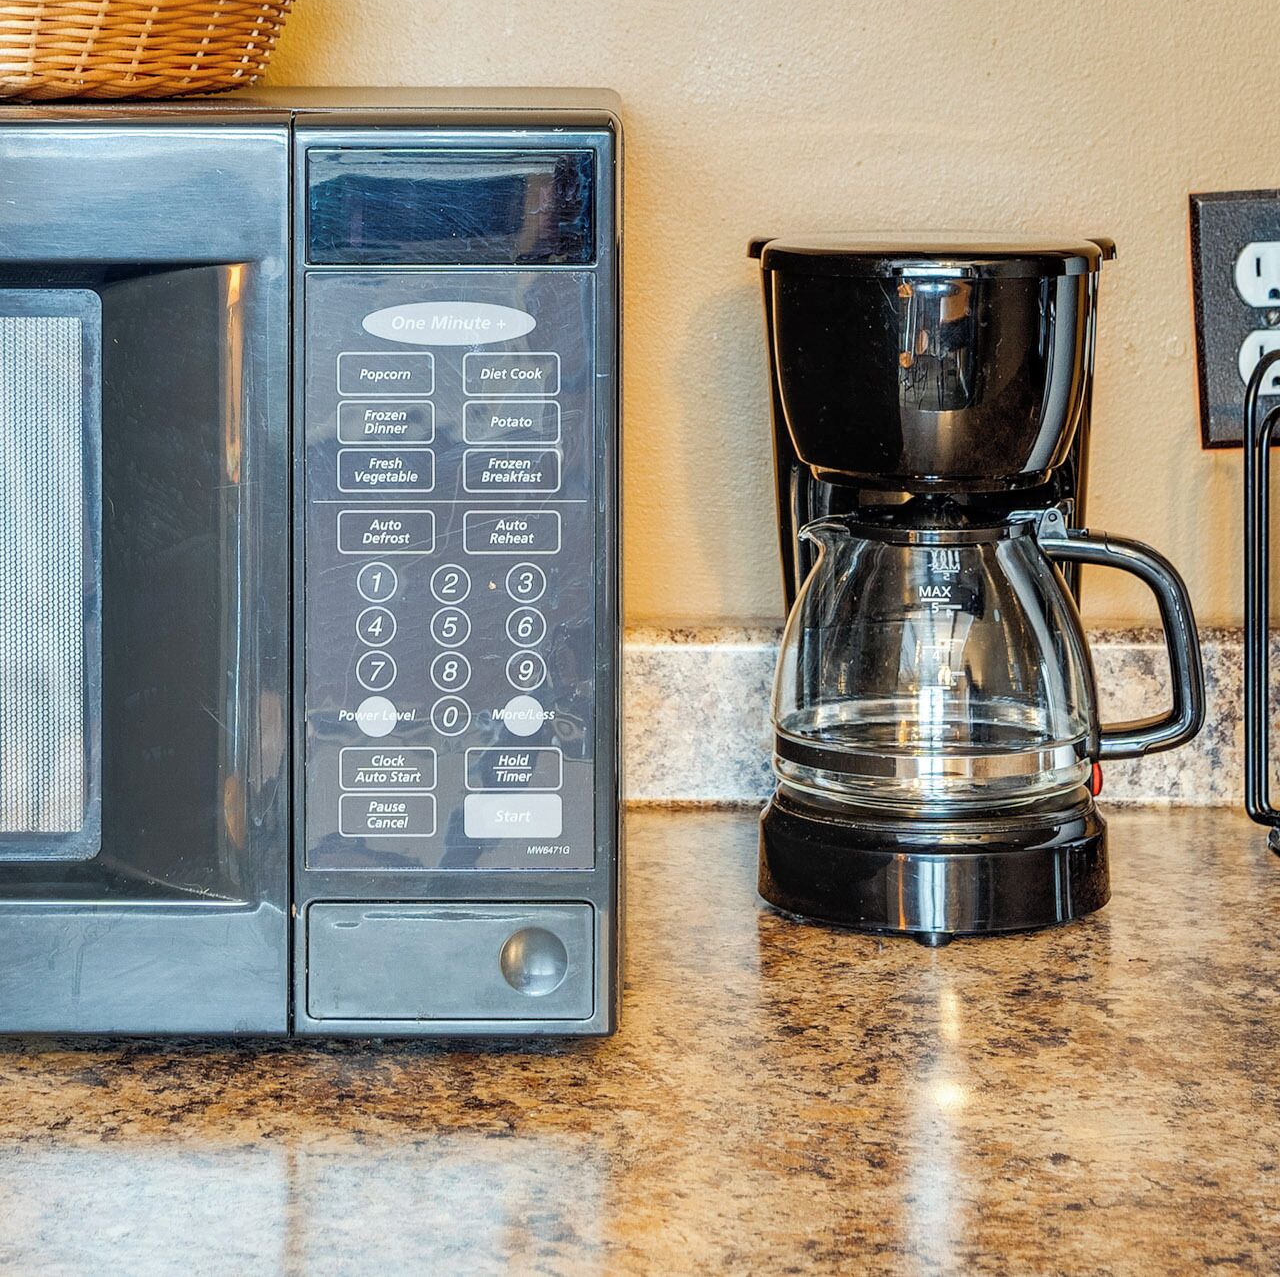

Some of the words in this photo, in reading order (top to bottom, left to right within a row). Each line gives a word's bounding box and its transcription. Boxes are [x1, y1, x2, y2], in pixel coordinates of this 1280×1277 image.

[391, 315, 426, 330] One
[431, 315, 491, 330] Minute
[359, 368, 411, 382] Popcorn
[480, 367, 507, 380] Diet
[510, 367, 542, 380] Cook
[364, 409, 407, 422] Frozen
[490, 416, 533, 428] Potato
[364, 422, 408, 434] Dinner
[369, 457, 403, 469] Fresh
[488, 457, 531, 469] Frozen
[354, 470, 419, 485] Vegetable
[481, 470, 542, 483] Breakfast
[369, 519, 402, 531] Auto
[494, 519, 528, 531] Auto
[362, 531, 410, 544] Defrost
[489, 531, 535, 544] Reheat
[371, 572, 382, 593] 1
[442, 573, 459, 593] 2
[517, 572, 534, 593] 3
[919, 585, 952, 598] MAX
[931, 602, 940, 614] 5
[367, 615, 383, 636] 4
[442, 617, 458, 637] 5
[517, 616, 533, 637] 6
[370, 661, 386, 682] 7
[442, 661, 458, 682] 8
[518, 660, 534, 681] 9
[338, 709, 379, 721] Power
[382, 709, 416, 721] Level
[442, 706, 459, 727] 0
[491, 708, 556, 721] More/Less
[370, 754, 405, 768] Clock
[498, 753, 529, 767] Hold
[354, 770, 387, 783] Auto
[389, 770, 422, 783] Start
[495, 770, 533, 783] Timer
[367, 801, 407, 814] Pause
[366, 815, 409, 829] Cancel
[494, 809, 532, 823] Start
